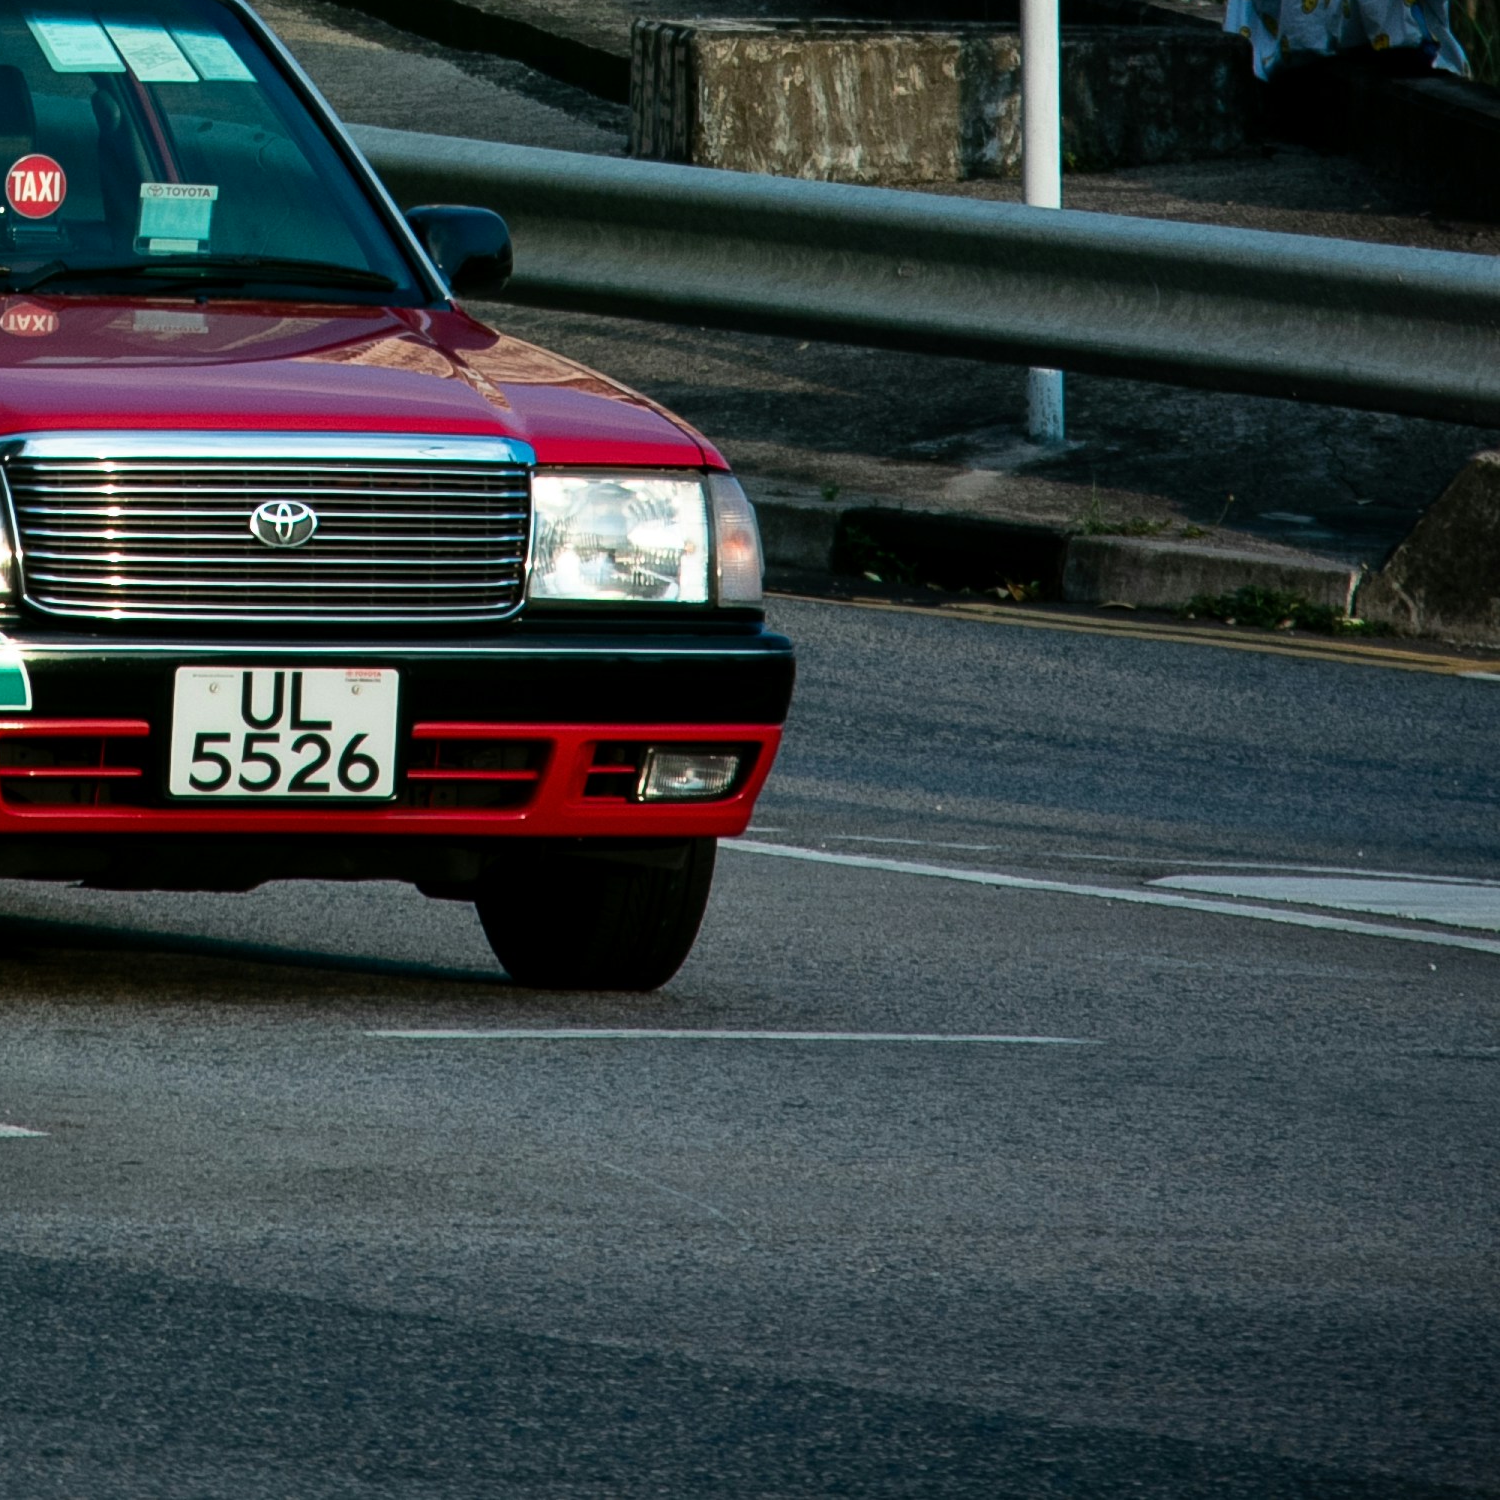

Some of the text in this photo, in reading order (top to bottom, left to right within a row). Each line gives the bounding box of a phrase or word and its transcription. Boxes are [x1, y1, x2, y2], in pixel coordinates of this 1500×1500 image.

[11, 170, 61, 203] TAXI
[166, 186, 211, 198] TOYOTA
[241, 671, 333, 731] UL
[188, 732, 380, 793] 5526
